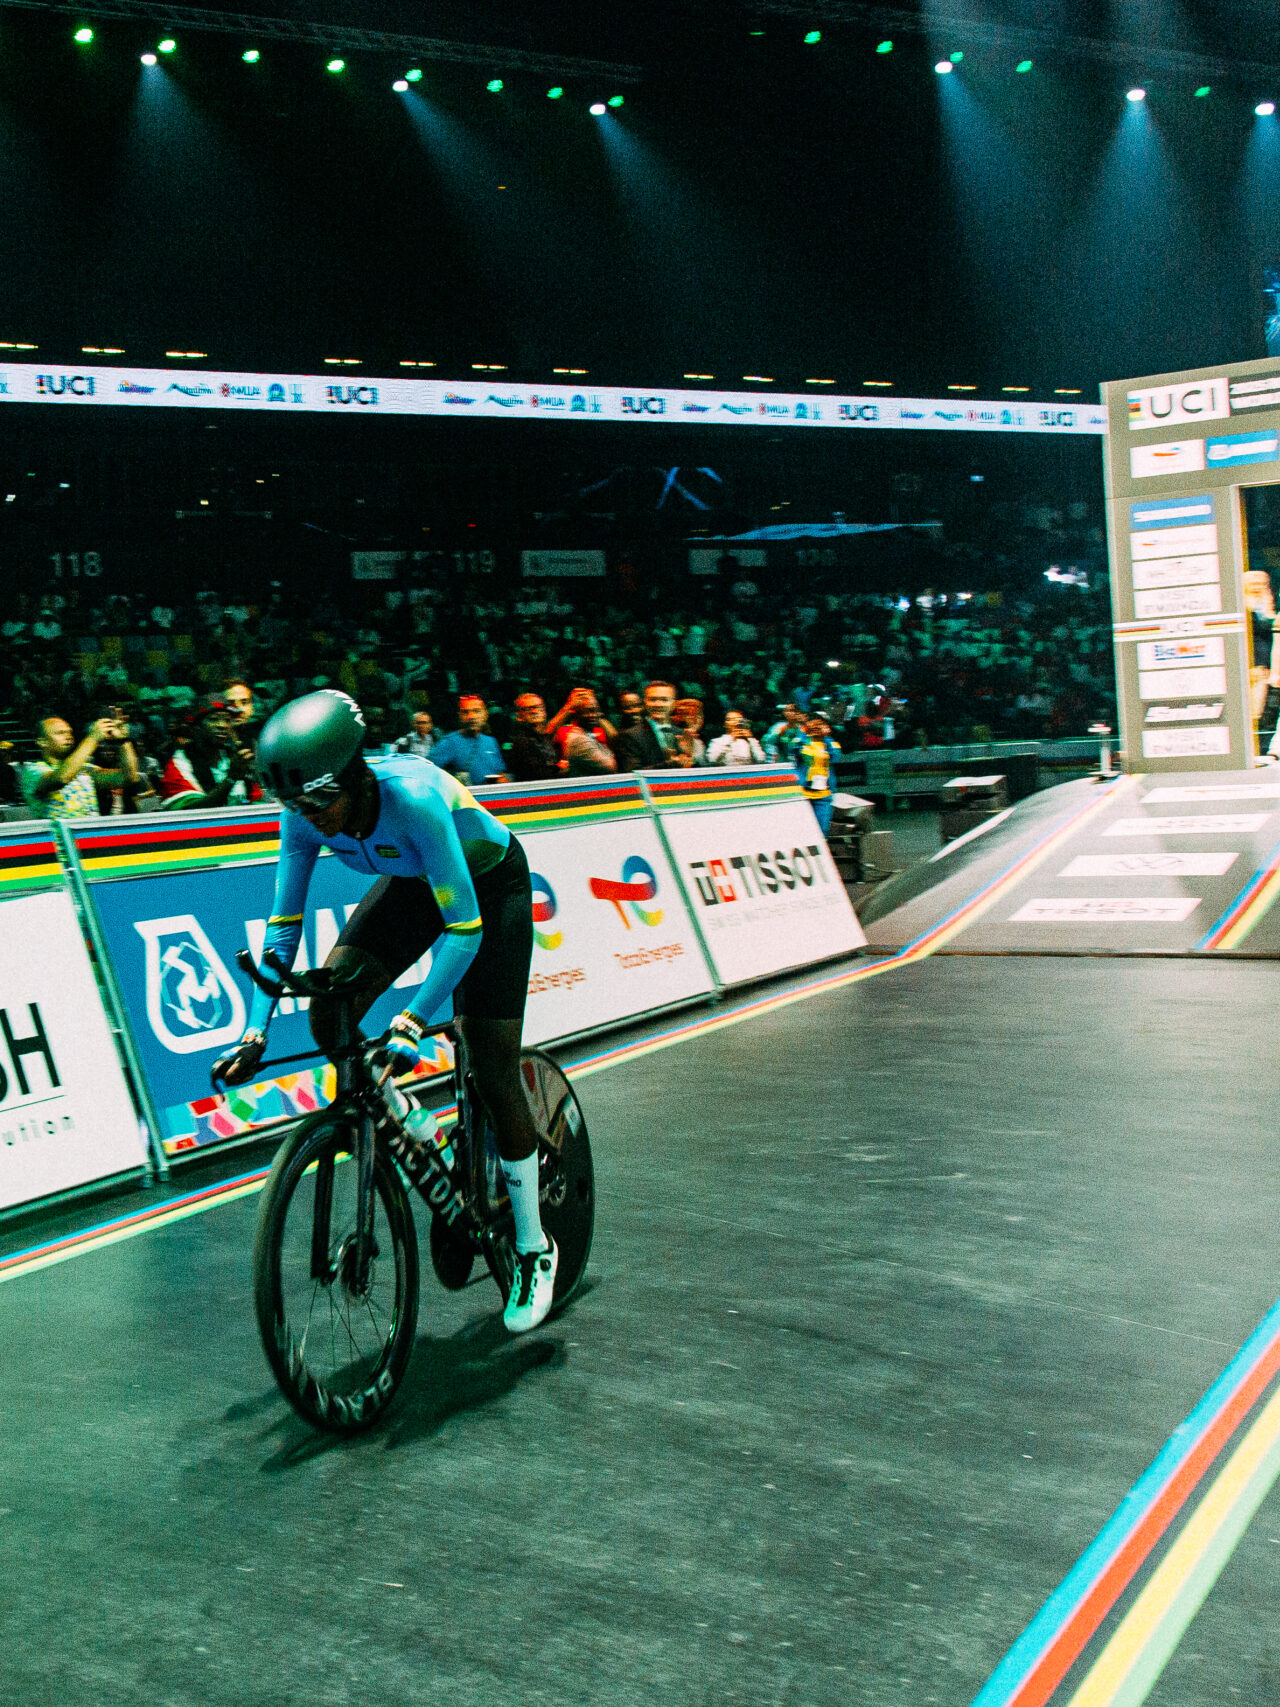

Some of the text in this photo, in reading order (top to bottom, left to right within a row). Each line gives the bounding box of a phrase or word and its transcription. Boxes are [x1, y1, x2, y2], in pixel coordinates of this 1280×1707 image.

[47, 374, 97, 397] UCI
[334, 385, 380, 406] UCI
[631, 396, 668, 415] UCI
[1150, 387, 1217, 419] UCI
[47, 550, 105, 577] 118
[302, 772, 334, 794] POC
[728, 844, 830, 899] TISSOT
[1033, 906, 1178, 916] TISSOT
[526, 967, 587, 995] lEnergies
